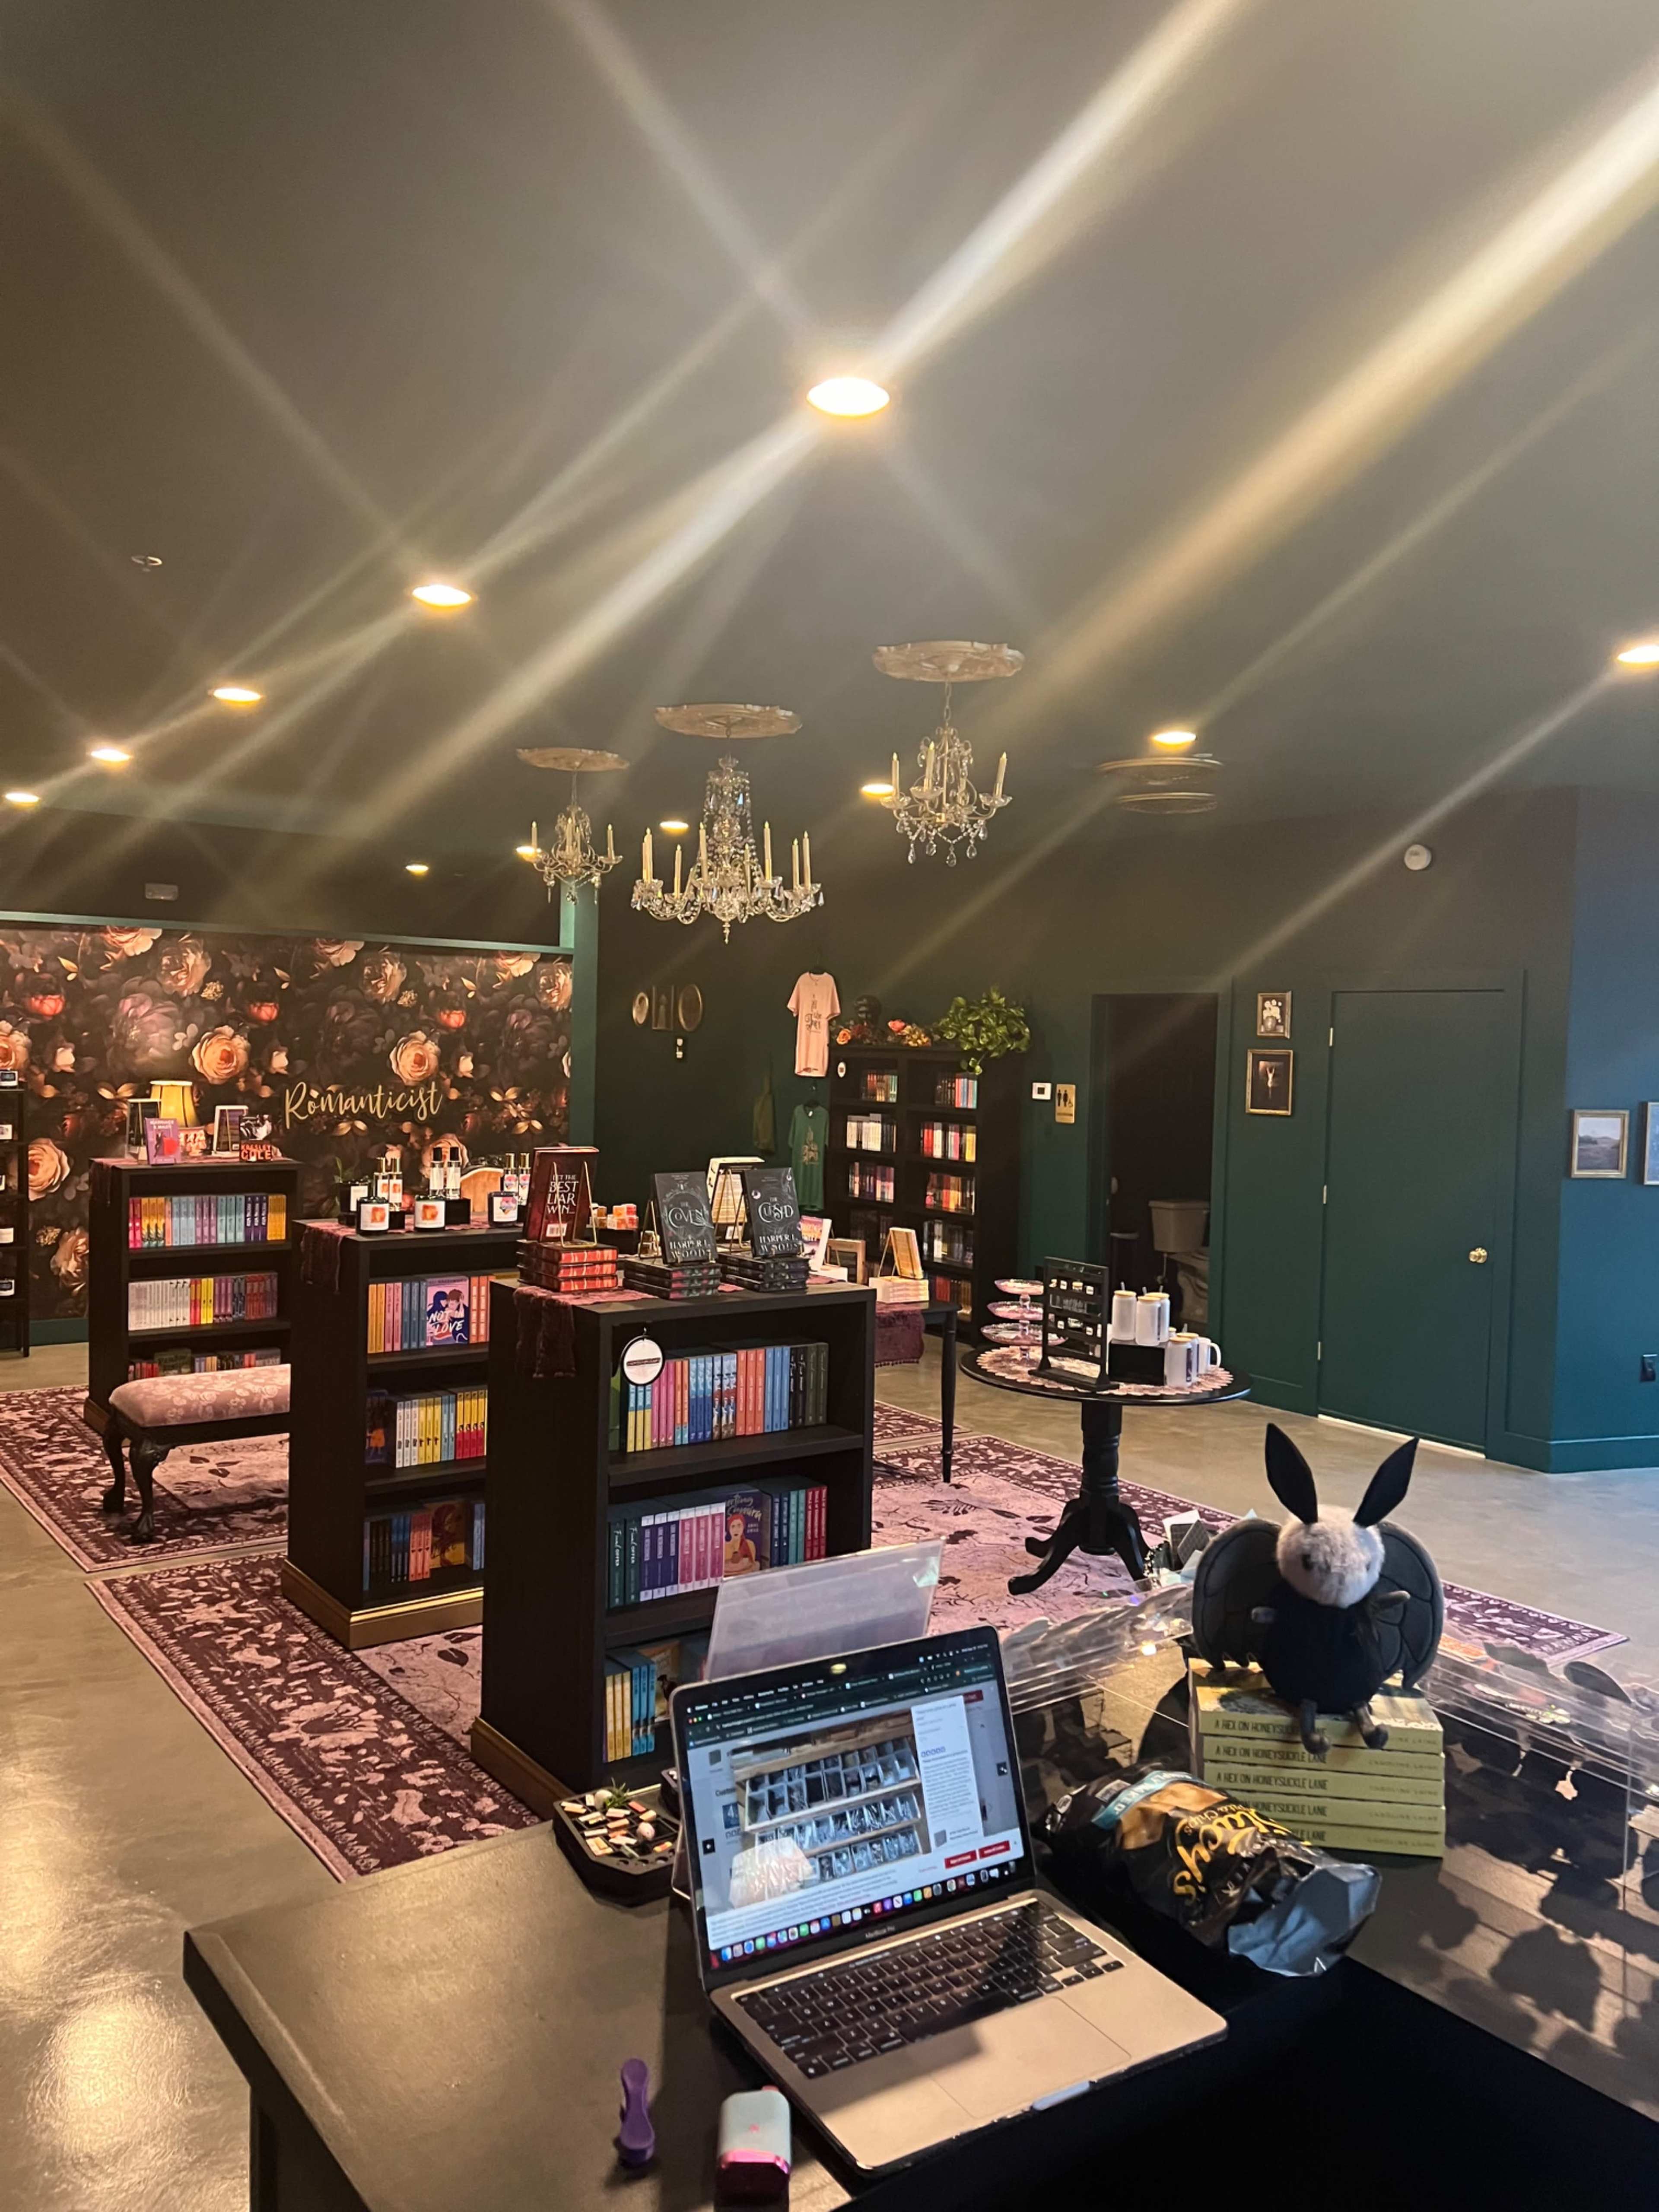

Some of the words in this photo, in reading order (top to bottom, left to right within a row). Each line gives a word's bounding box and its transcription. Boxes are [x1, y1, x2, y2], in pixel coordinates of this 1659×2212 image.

[285, 1081, 443, 1129] Romanticist
[241, 1150, 273, 1160] COLE
[549, 1181, 579, 1192] BEST
[547, 1193, 576, 1206] LIAR
[669, 1208, 710, 1228] COVEN
[759, 1202, 794, 1223] CURSED
[760, 1234, 790, 1243] HARPER
[671, 1249, 709, 1258] WOOD
[428, 1310, 452, 1322] NOT
[433, 1319, 465, 1336] LOVE
[1222, 1720, 1236, 1729] HEX
[1238, 1721, 1249, 1729] ON
[1215, 1746, 1220, 1755] A
[1223, 1747, 1236, 1756] HEX
[1239, 1748, 1250, 1757] ON
[1252, 1748, 1306, 1762] HONEYSUCKLE
[1308, 1753, 1327, 1764] LANE
[1217, 1773, 1222, 1781] A
[1224, 1773, 1237, 1783] HEX
[1239, 1774, 1251, 1783] ON
[1253, 1775, 1306, 1789] HONEYSUCKLE
[1309, 1779, 1328, 1789] LANE
[1253, 1800, 1306, 1816] HONEYSUCKLE
[1308, 1805, 1327, 1816] LANE
[1183, 1809, 1218, 1836] Chips
[1307, 1830, 1325, 1841] LANE
